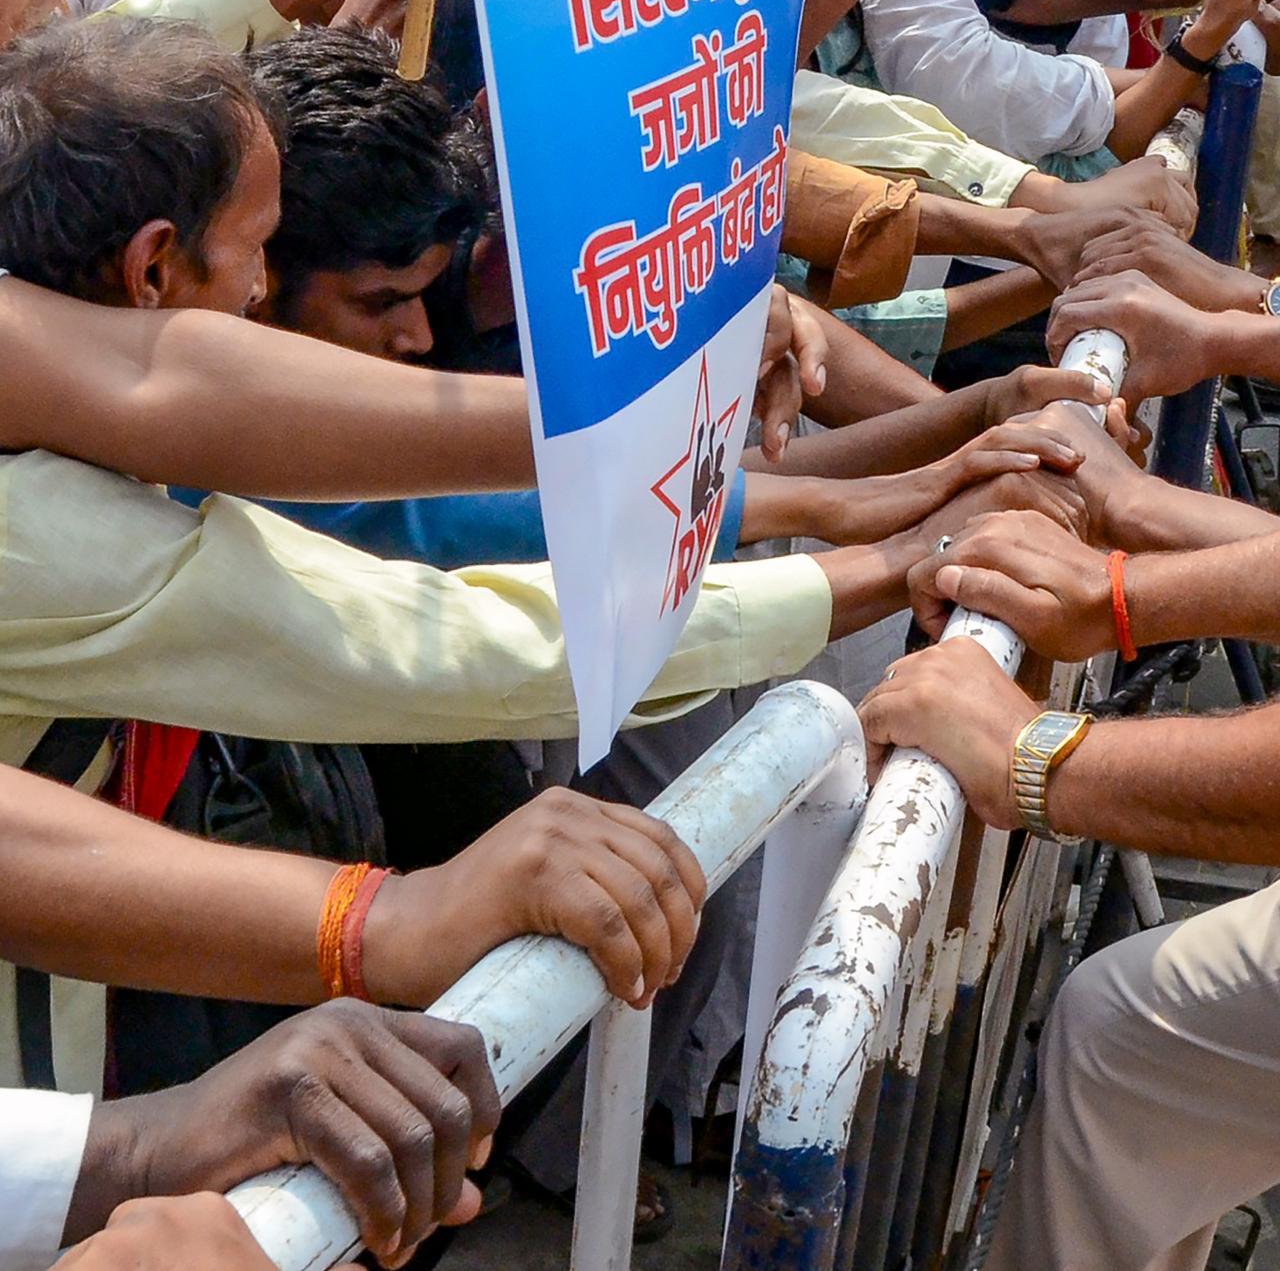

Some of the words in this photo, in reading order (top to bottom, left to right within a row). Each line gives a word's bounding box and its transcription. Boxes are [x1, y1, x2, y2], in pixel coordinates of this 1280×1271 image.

[628, 31, 722, 172] जजों
[722, 10, 767, 128] की
[573, 183, 716, 358] नियुक्ति
[719, 156, 764, 267] बंद
